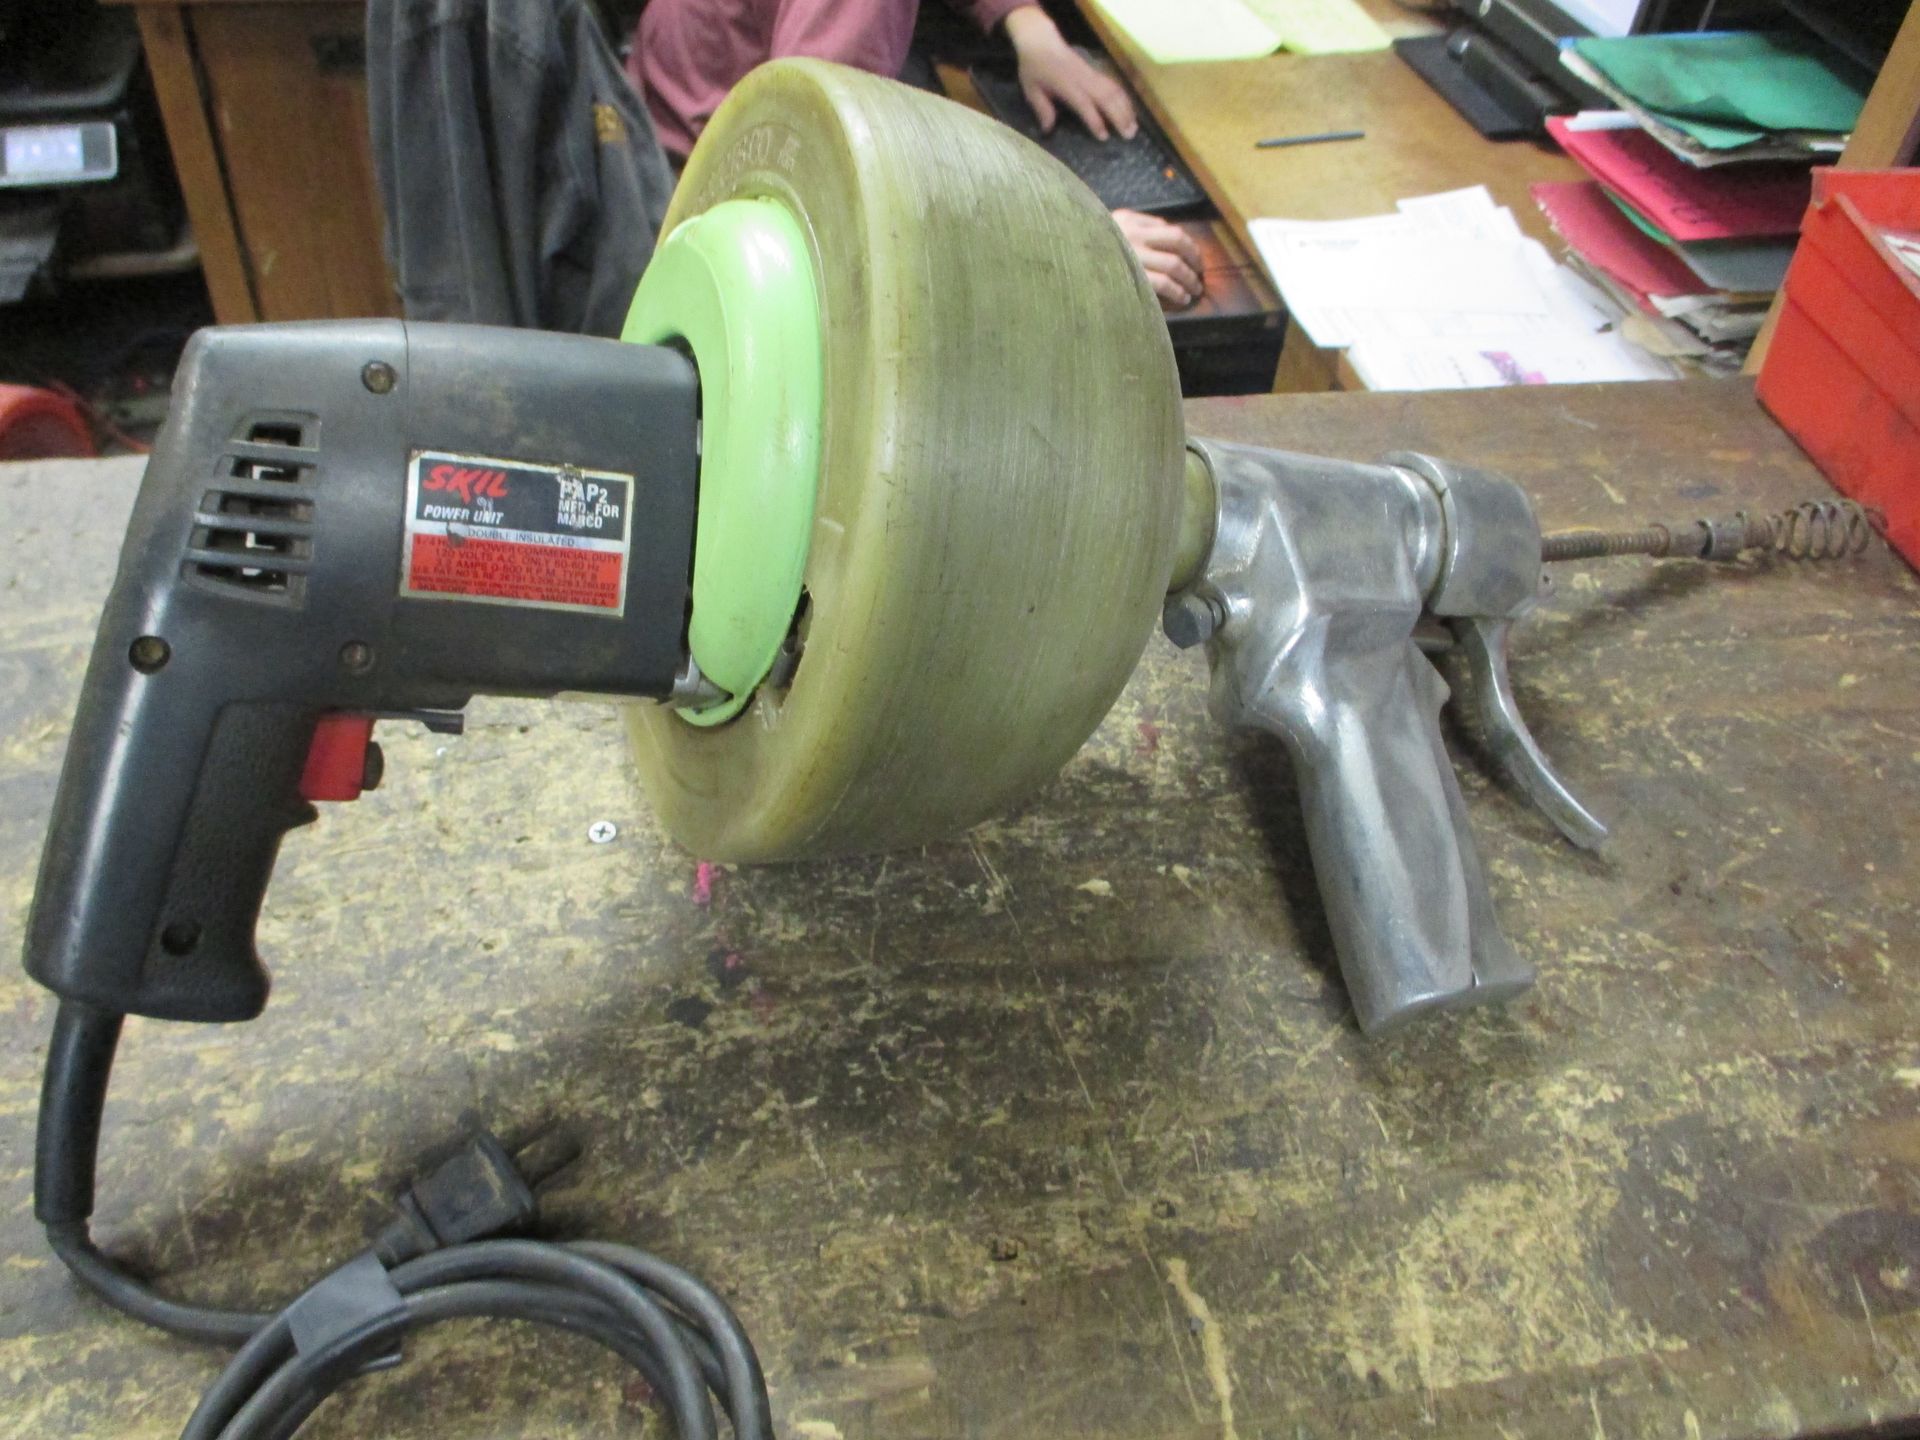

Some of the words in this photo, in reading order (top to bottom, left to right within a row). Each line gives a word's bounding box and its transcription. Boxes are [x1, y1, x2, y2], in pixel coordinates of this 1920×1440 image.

[422, 464, 509, 505] SKIL
[423, 504, 470, 520] POWER
[473, 510, 504, 524] UNIT
[595, 503, 620, 518] FOR
[467, 529, 510, 541] DOUBLE
[515, 534, 575, 548] INSULATED
[517, 544, 588, 559] COMMERCIAL
